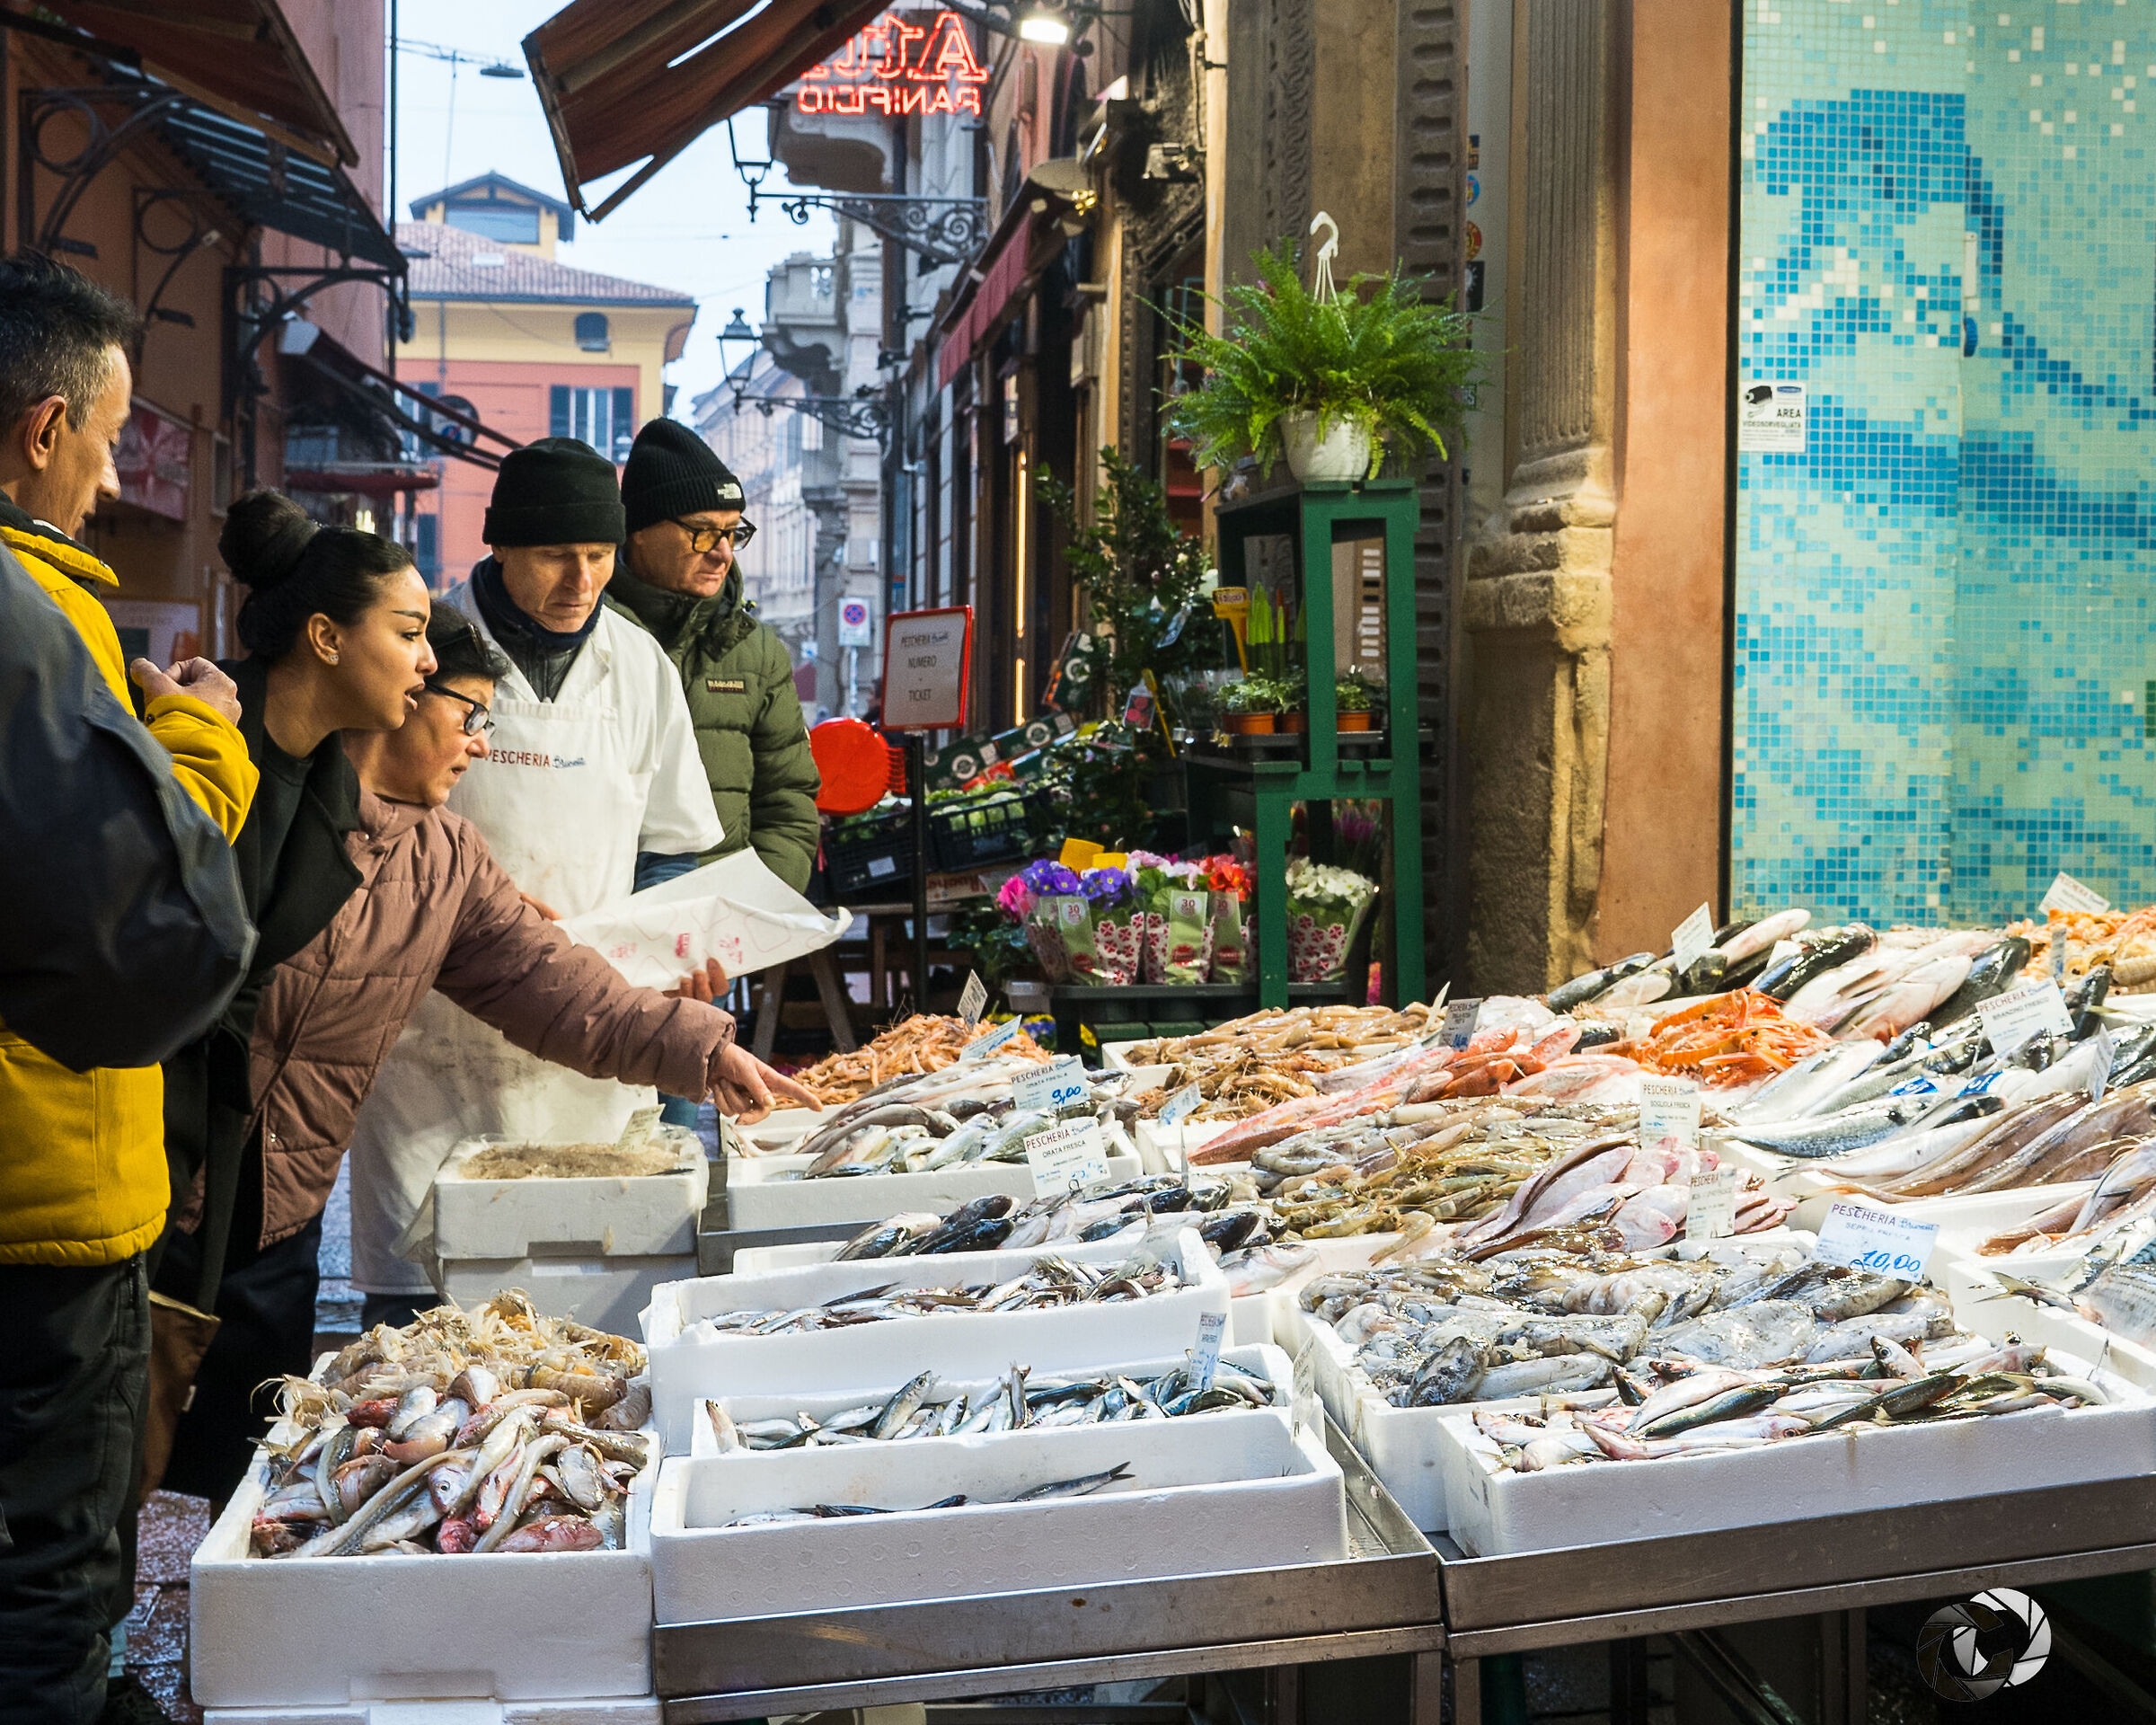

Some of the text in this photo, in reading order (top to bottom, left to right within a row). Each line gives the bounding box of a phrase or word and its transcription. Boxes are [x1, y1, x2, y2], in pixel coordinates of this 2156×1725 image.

[1777, 409, 1801, 419] AREA
[907, 655, 937, 668] NUMERO
[907, 688, 932, 701] TICKET
[484, 748, 550, 768] PESCHERIA
[1180, 898, 1196, 907] 30
[1978, 991, 2027, 1014] PESCHERIA
[1011, 1066, 1054, 1084] PESCHERIA
[1050, 1085, 1082, 1105] 9,00
[1643, 1084, 1678, 1095] PESCHERIA
[1026, 1128, 1071, 1151] PESCHERIA
[1042, 1139, 1086, 1158] ORATA FRESCA
[1831, 1203, 1896, 1227] PESCHERIA
[1862, 1250, 1922, 1273] 10,00
